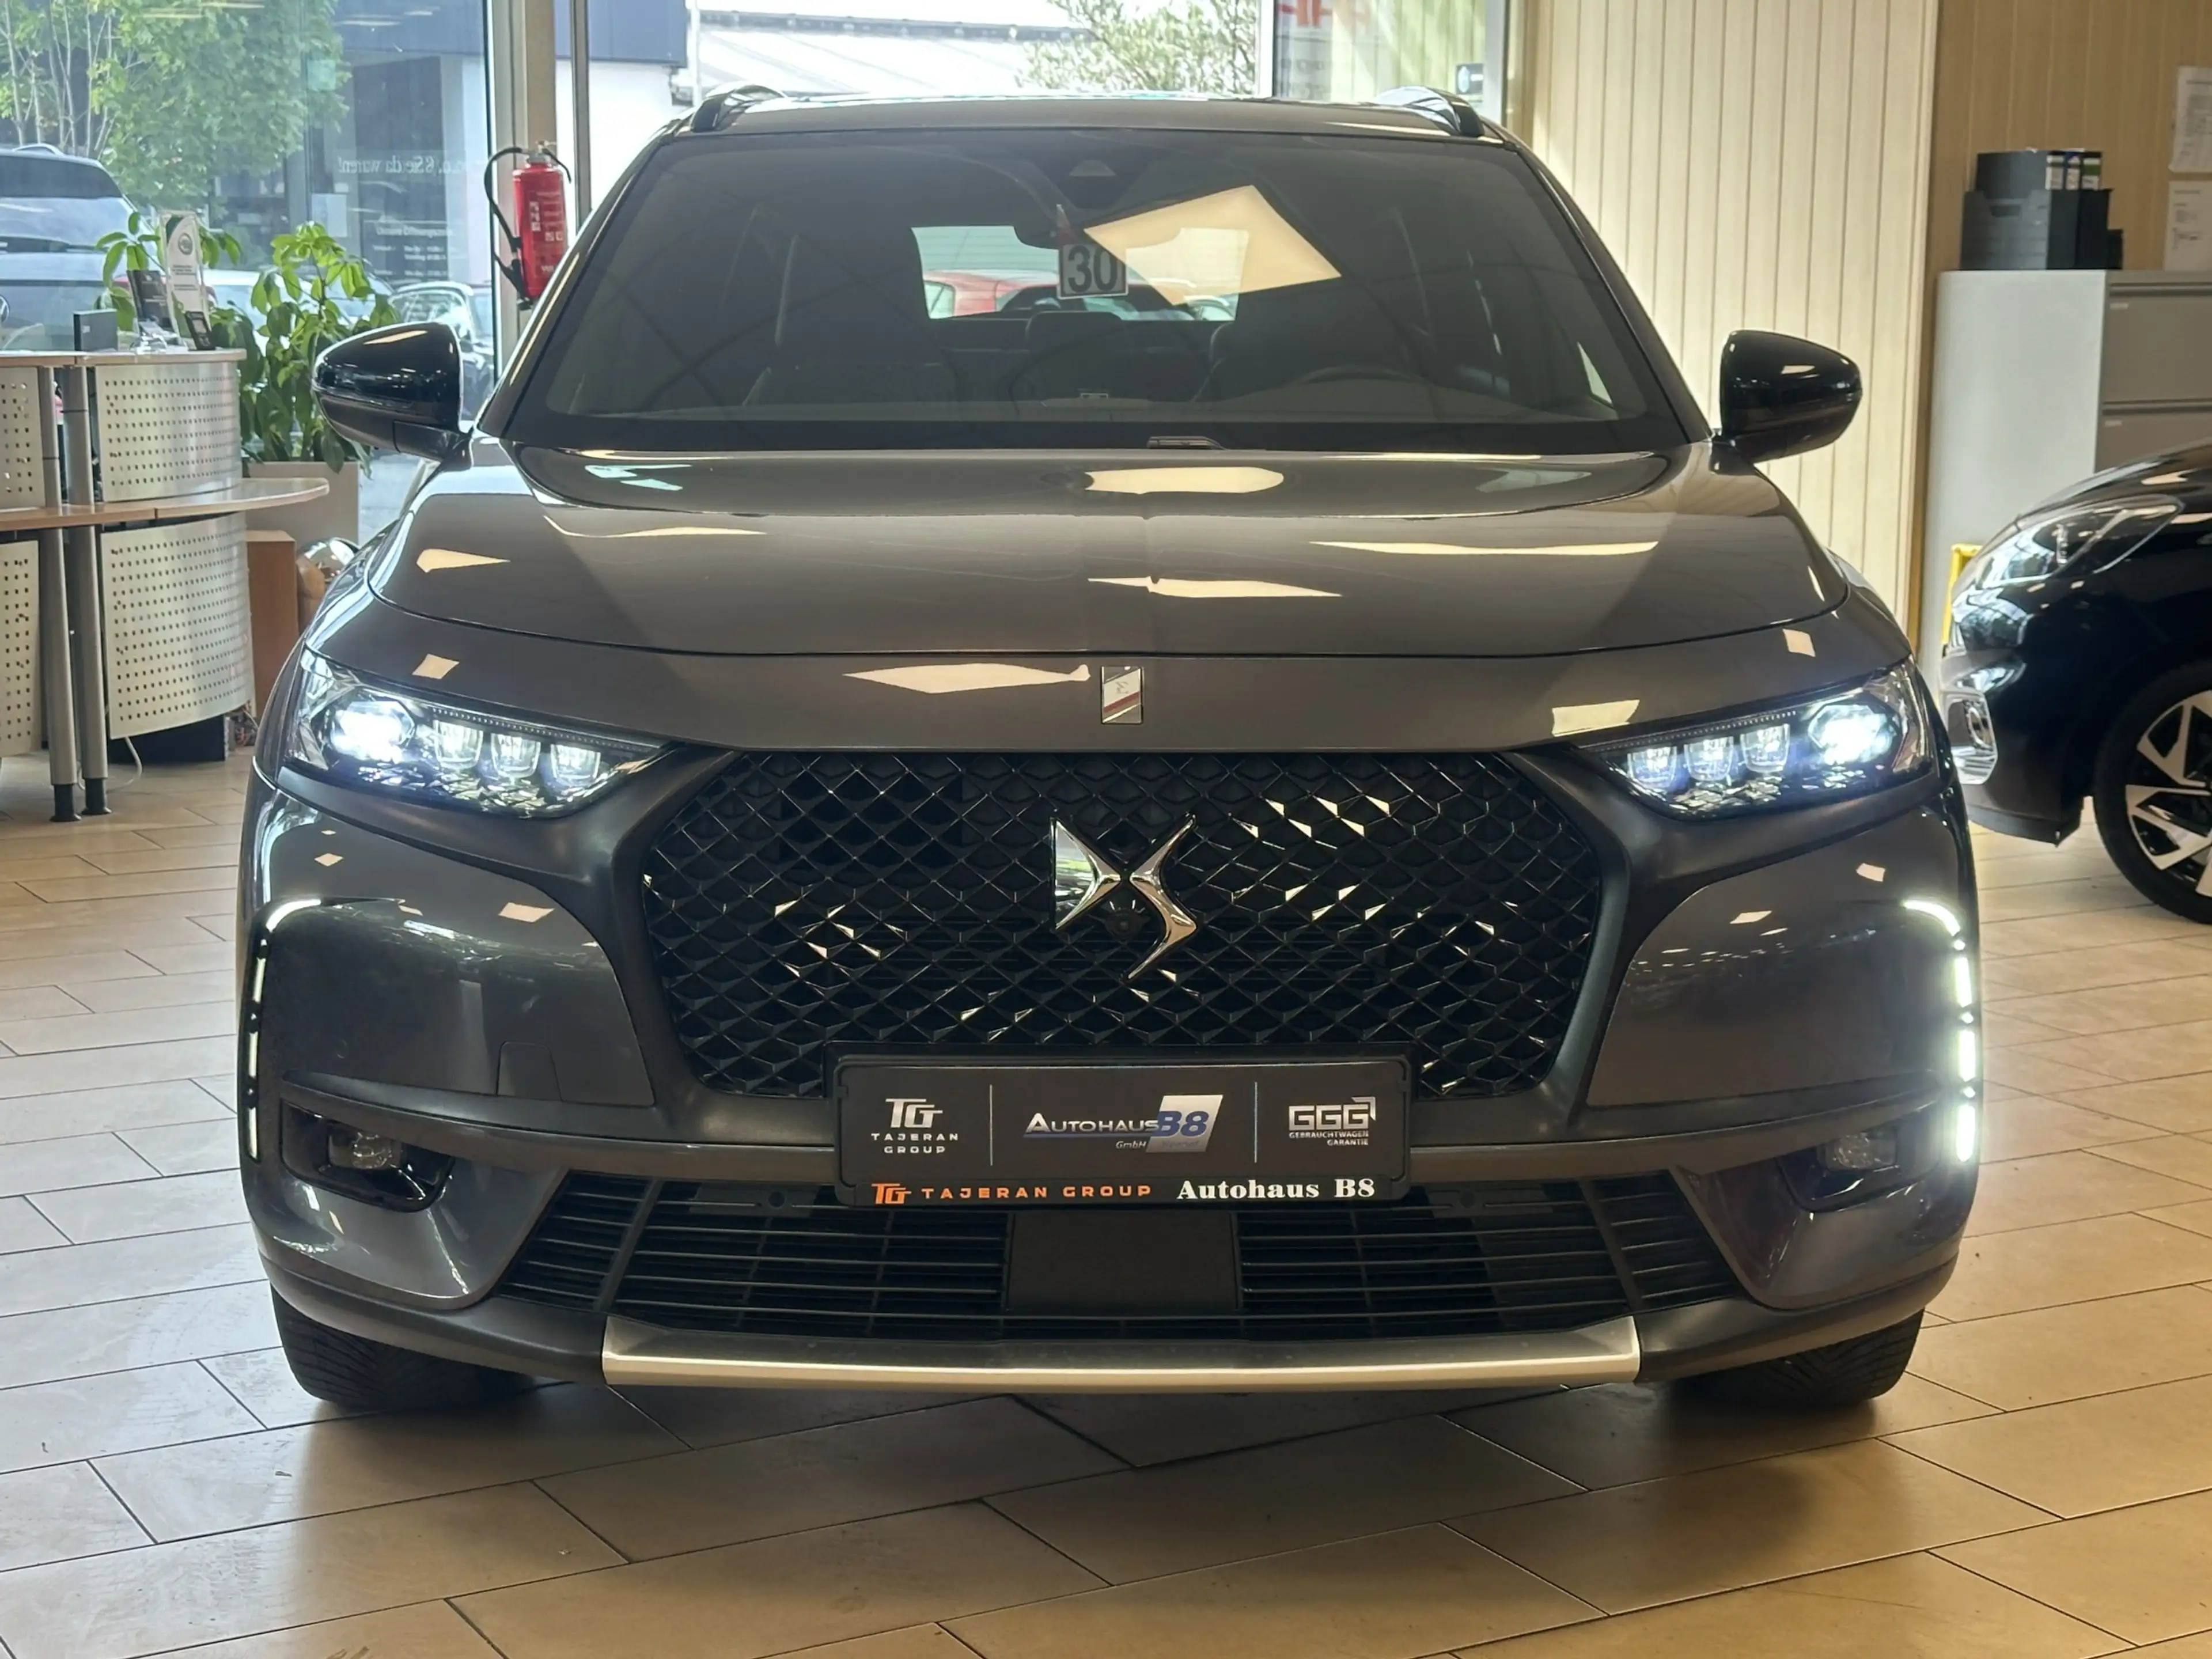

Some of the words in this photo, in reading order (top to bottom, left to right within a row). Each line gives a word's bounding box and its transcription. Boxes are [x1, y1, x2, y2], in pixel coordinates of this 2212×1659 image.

[1068, 245, 1118, 293] 30
[1289, 1104, 1369, 1131] GGG
[1152, 1111, 1210, 1137] B8
[870, 1132, 959, 1141] TAJERAN
[1289, 1130, 1369, 1139] GEBRAUCHTWAGEN
[1115, 1140, 1147, 1149] GmbH
[1327, 1138, 1369, 1146] GARANTIE
[884, 1146, 945, 1154] GROUP
[921, 1187, 1047, 1199] TAJERAN
[1063, 1185, 1151, 1198] GROUP
[1176, 1179, 1320, 1200] Autohaus
[1334, 1178, 1375, 1198] B8
